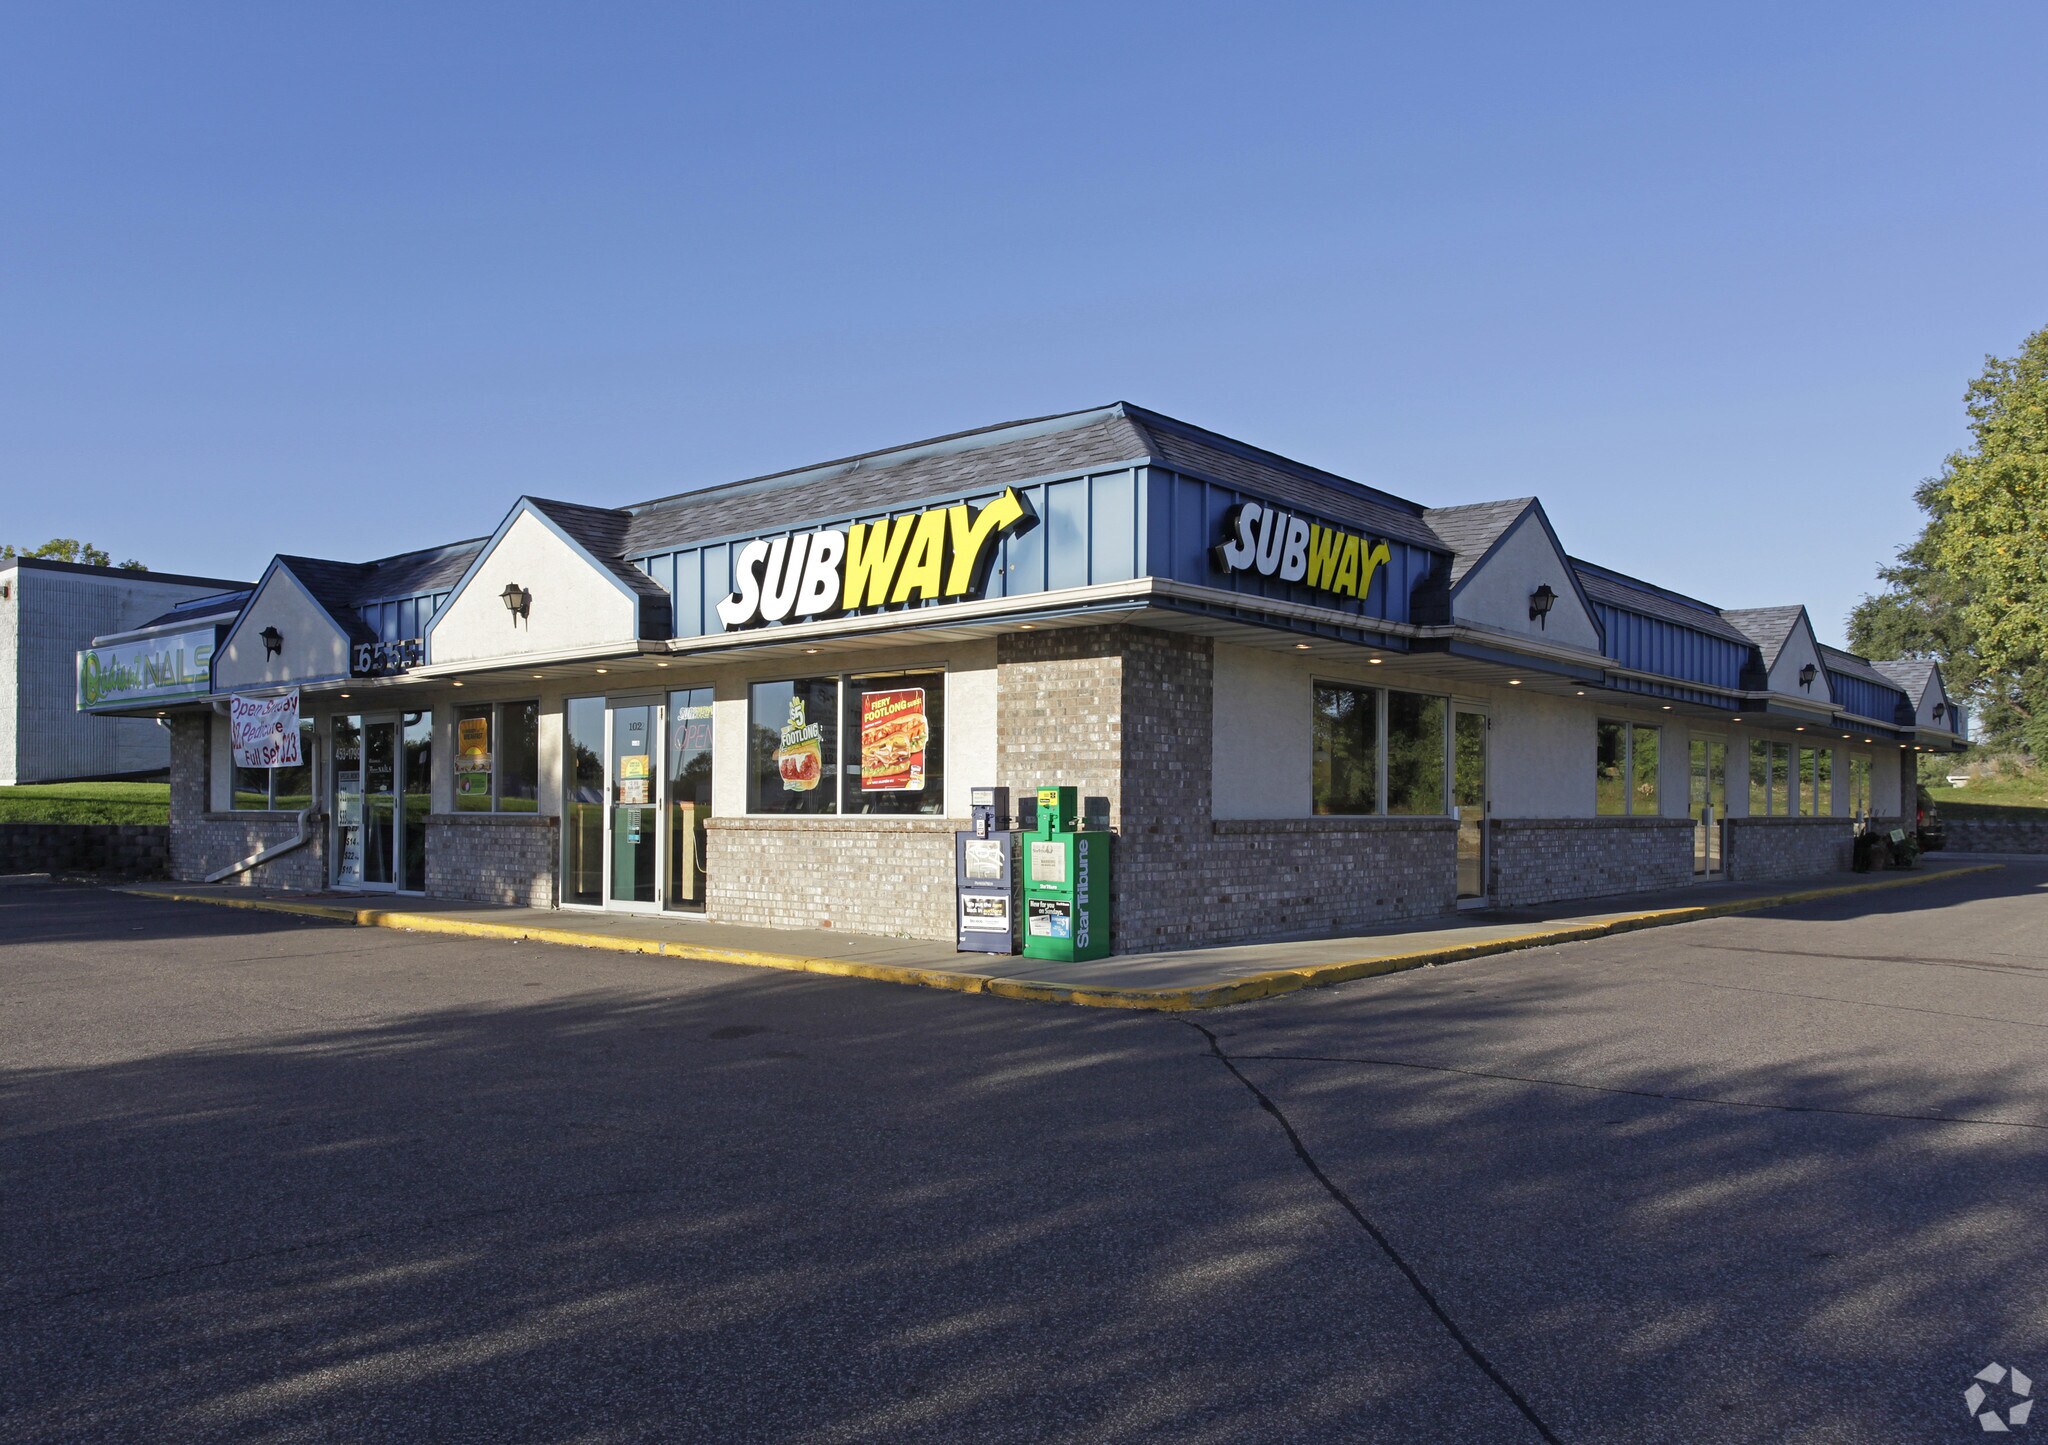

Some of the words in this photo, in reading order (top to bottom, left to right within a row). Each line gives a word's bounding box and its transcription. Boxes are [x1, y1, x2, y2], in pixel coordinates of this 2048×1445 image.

[716, 485, 1024, 631] SUBWAY
[1223, 502, 1392, 600] SUBWAY
[144, 644, 212, 689] NAILS
[231, 698, 262, 719] Open
[790, 704, 804, 726] $5
[864, 700, 907, 722] FOOTLONG
[871, 696, 891, 710] FIERY
[674, 724, 713, 750] OPEN
[781, 724, 819, 748] FOOTLONG
[245, 748, 261, 766] Full
[262, 740, 280, 765] Set
[1077, 839, 1089, 909] Tribune
[1077, 908, 1089, 948] Star
